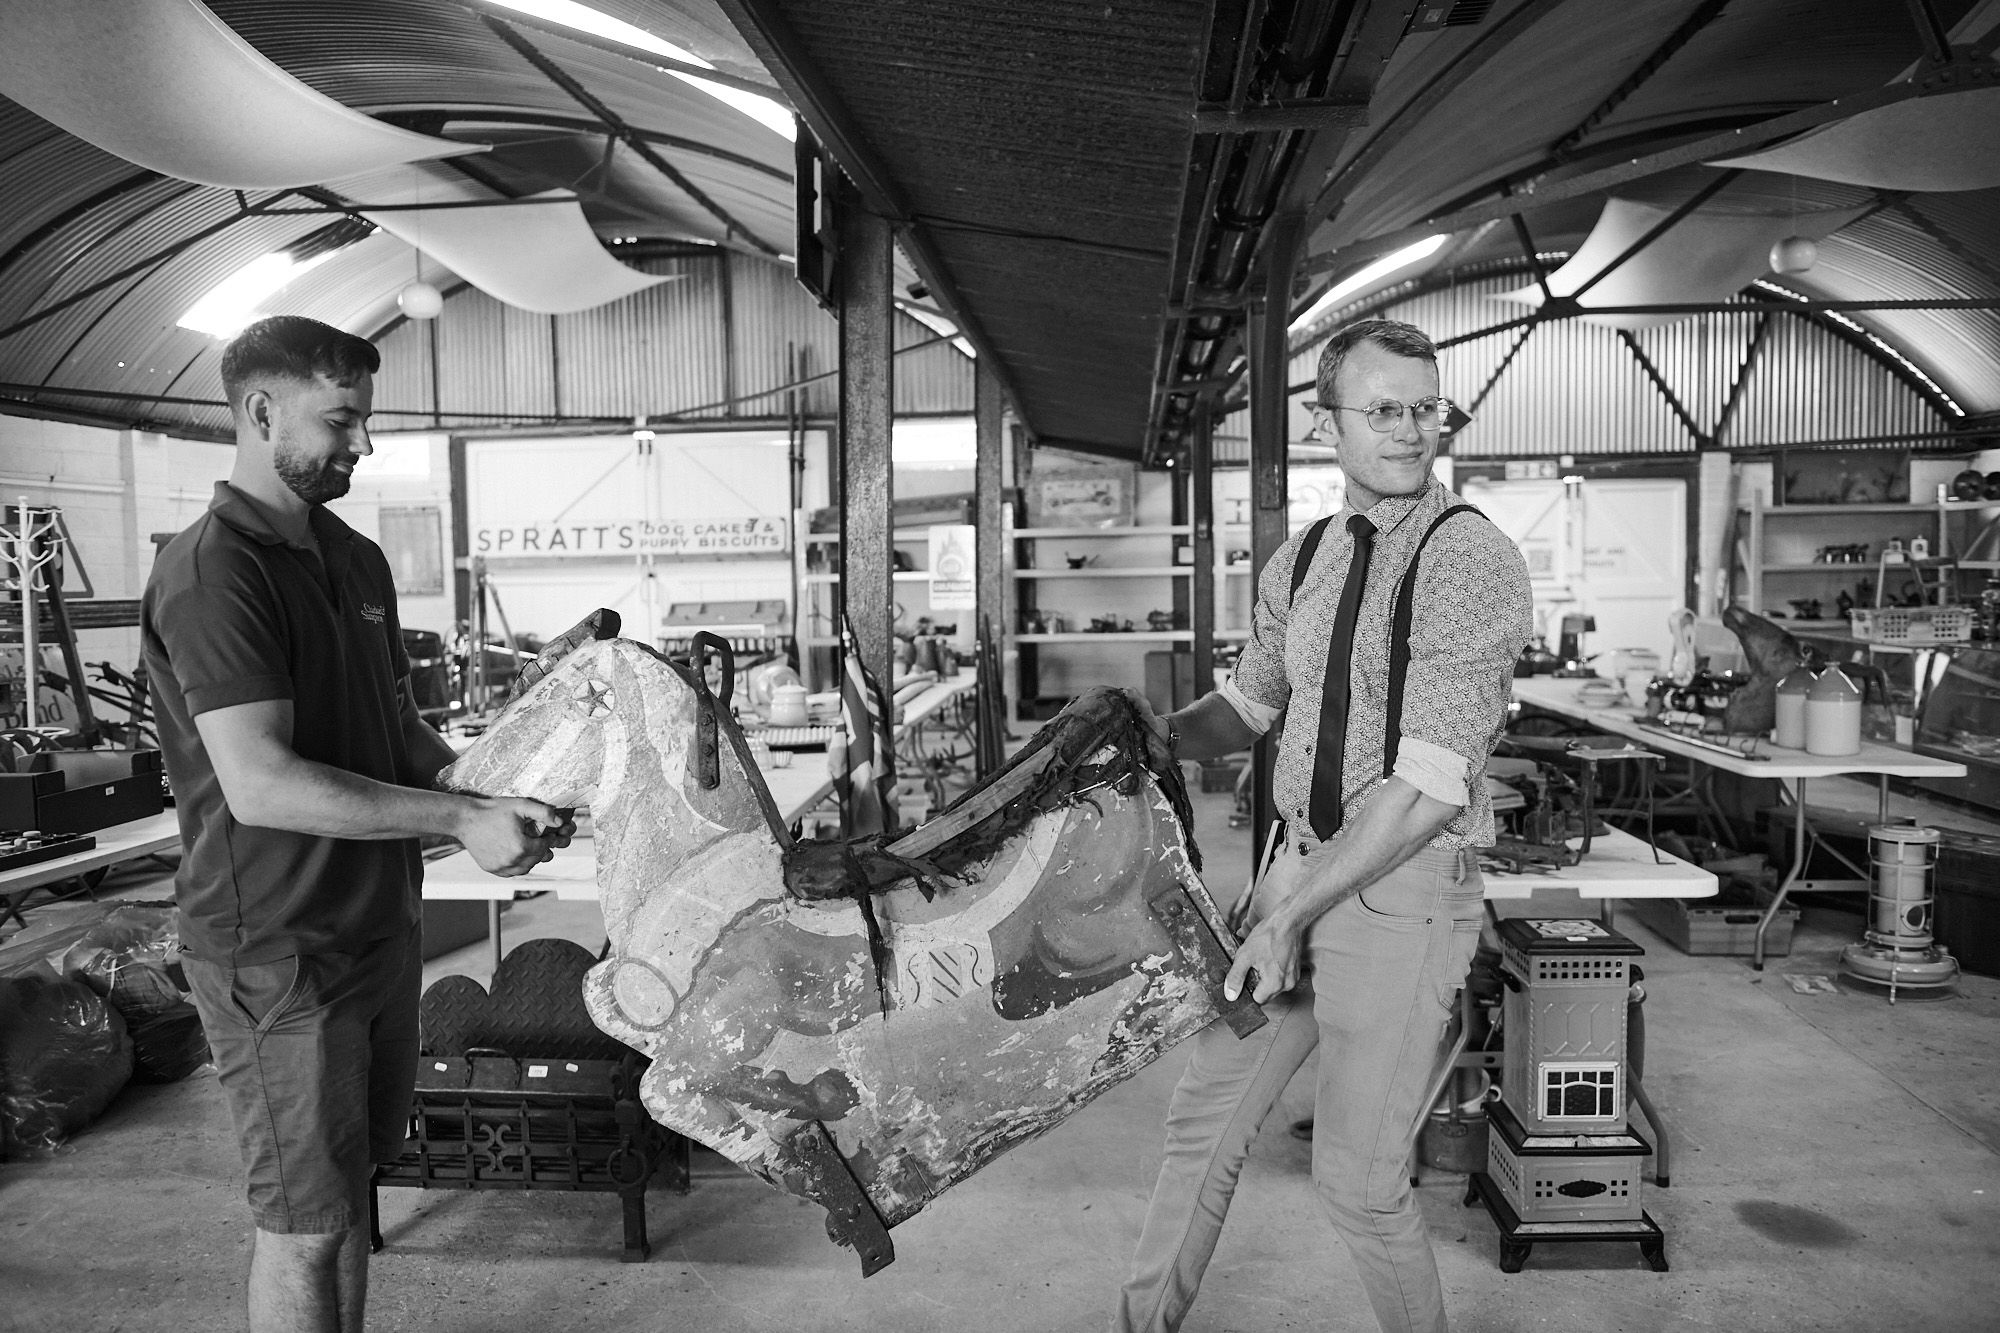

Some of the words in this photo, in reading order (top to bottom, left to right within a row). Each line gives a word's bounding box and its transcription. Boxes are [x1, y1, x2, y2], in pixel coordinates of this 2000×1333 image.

[644, 524, 685, 536] DOG
[693, 522, 756, 536] CAKES
[477, 523, 634, 552] SPRATT'S
[639, 537, 690, 549] PUPPY
[699, 535, 781, 548] BISCUITS
